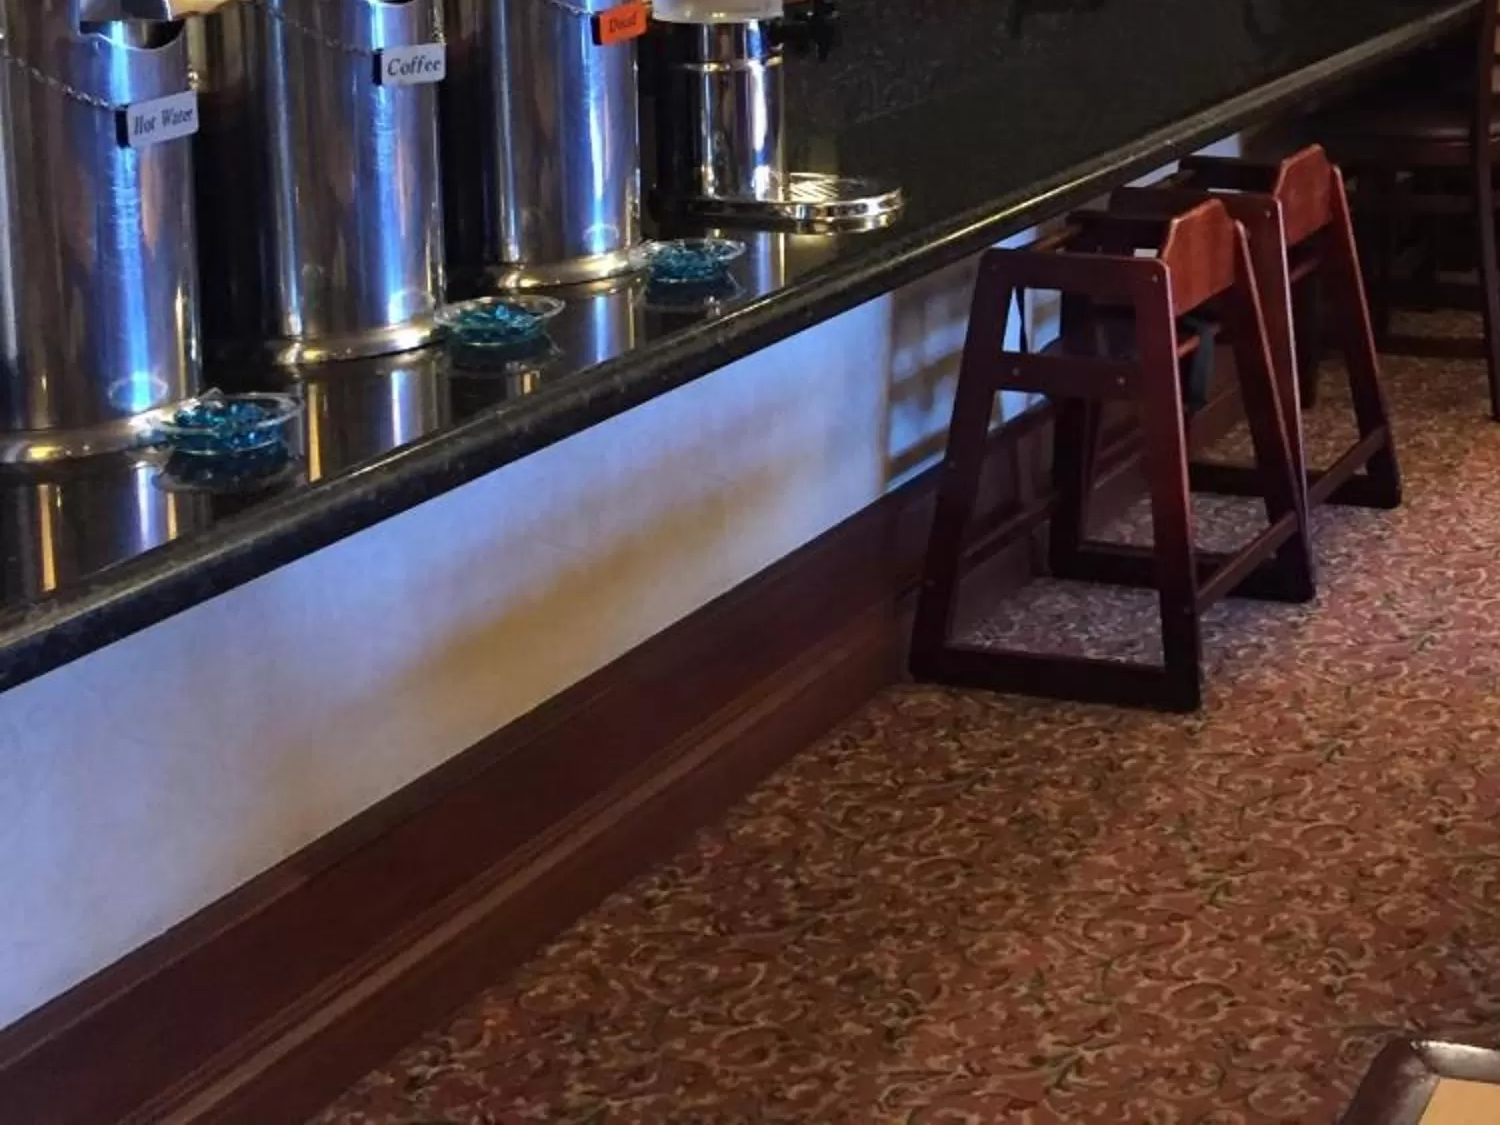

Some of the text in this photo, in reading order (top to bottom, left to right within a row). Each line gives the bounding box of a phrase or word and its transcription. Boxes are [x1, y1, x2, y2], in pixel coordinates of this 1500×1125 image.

[387, 54, 442, 77] Coffee
[133, 106, 194, 136] Hot Water
